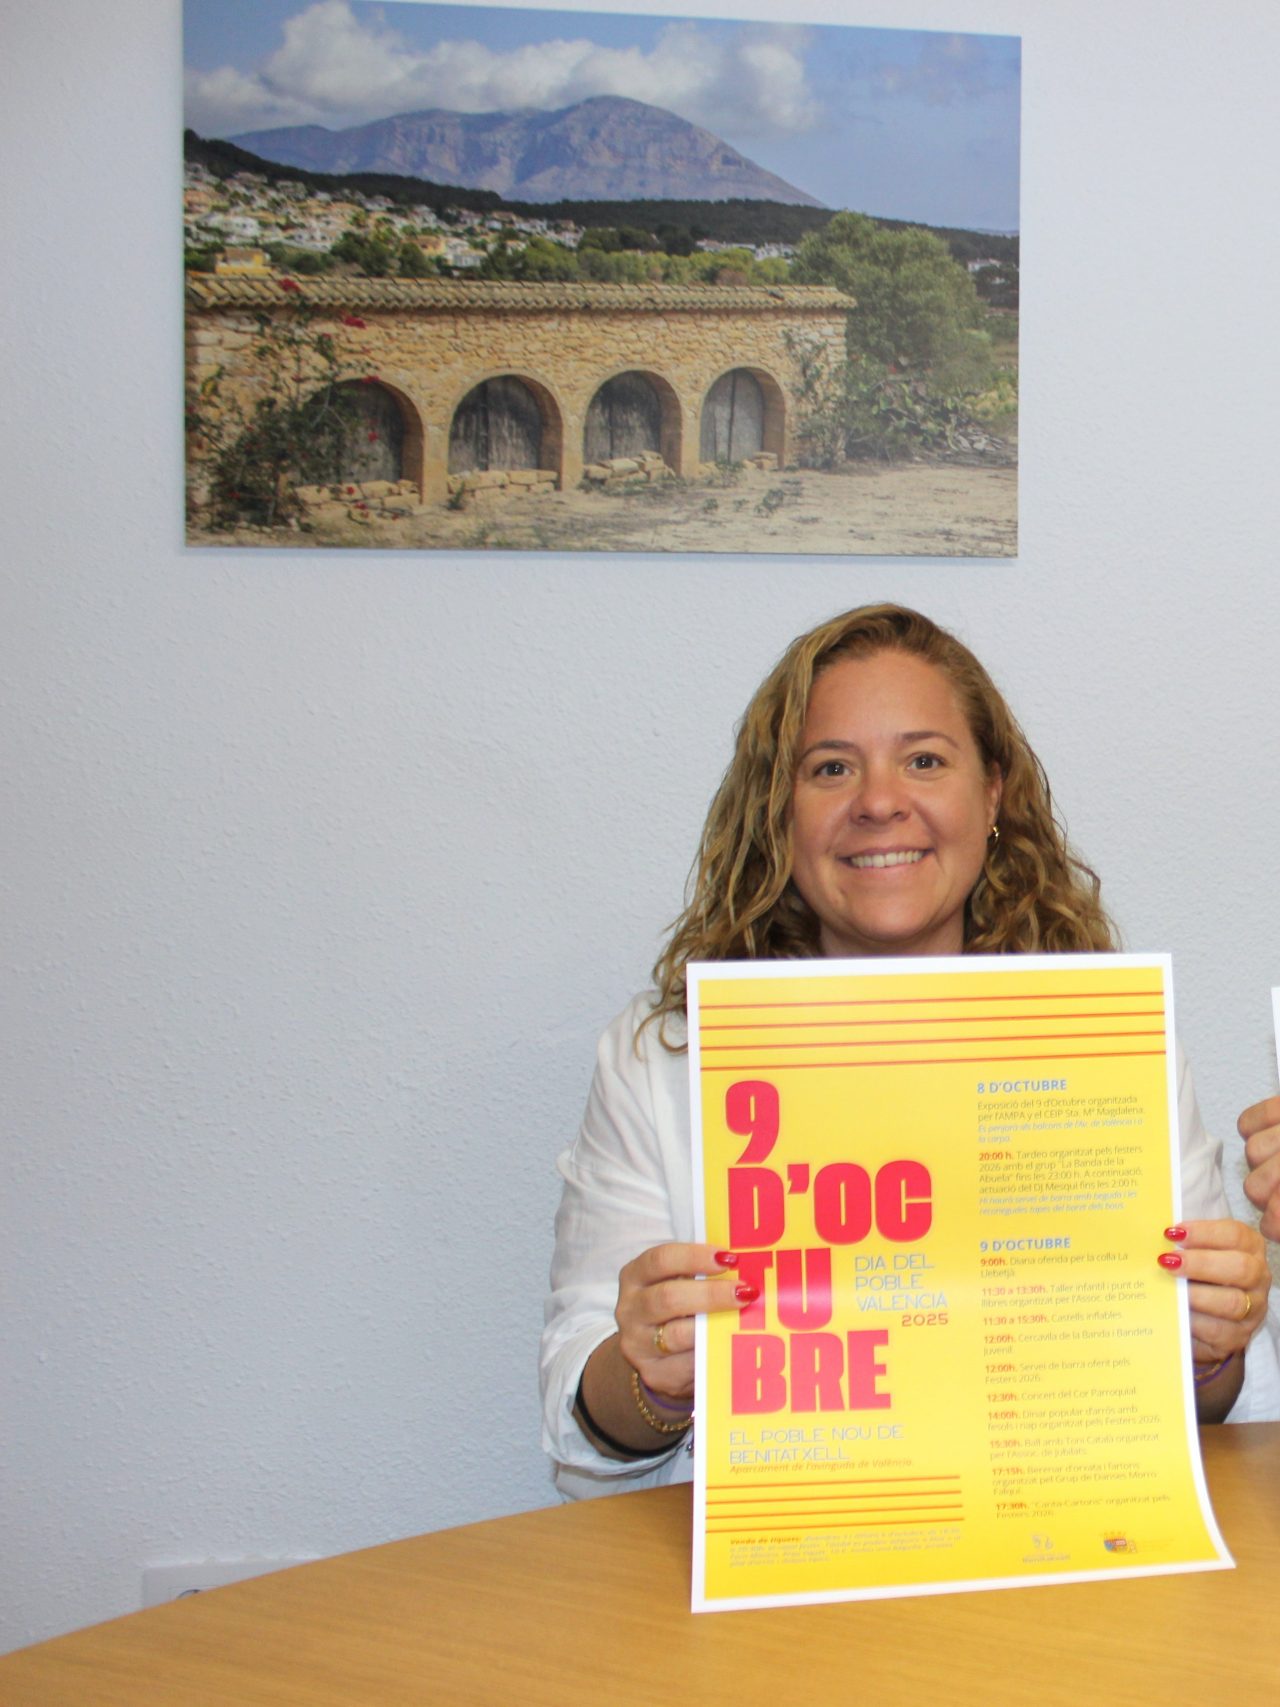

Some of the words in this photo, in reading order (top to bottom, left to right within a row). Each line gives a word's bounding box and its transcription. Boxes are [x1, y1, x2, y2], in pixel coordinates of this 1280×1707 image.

[976, 1083, 985, 1093] 8
[988, 1079, 1067, 1093] D'OCTUBRE
[977, 1100, 1018, 1112] Exposició
[1020, 1099, 1034, 1108] del
[1087, 1094, 1137, 1107] organitzada
[725, 1081, 780, 1163] 9
[977, 1114, 993, 1123] per
[1033, 1110, 1042, 1119] el
[1043, 1109, 1063, 1118] CEIP
[978, 1151, 1003, 1161] 20:00
[1004, 1151, 1013, 1160] h.
[1017, 1149, 1047, 1159] Tardeo
[1049, 1147, 1092, 1160] organitzat
[1094, 1146, 1112, 1157] pels
[1114, 1144, 1142, 1154] festers
[979, 1163, 1000, 1172] 2026
[1002, 1162, 1023, 1171] amb
[1025, 1161, 1033, 1170] el
[1034, 1162, 1056, 1172] grup
[1073, 1158, 1102, 1168] Banda
[1103, 1157, 1115, 1166] de
[1116, 1157, 1124, 1166] la
[727, 1160, 933, 1249] D'OC
[979, 1241, 988, 1252] 9
[992, 1237, 1070, 1251] D'OCTUBRE
[855, 1256, 886, 1272] DIA
[894, 1254, 934, 1270] DEL
[980, 1257, 1008, 1266] 9:00h.
[1009, 1256, 1035, 1265] Diana
[1069, 1256, 1084, 1265] per
[1086, 1253, 1094, 1262] la
[1096, 1252, 1116, 1262] colla
[1117, 1252, 1128, 1261] La
[731, 1248, 832, 1331] TU
[856, 1274, 924, 1290] POBLE
[982, 1287, 1005, 1296] 11:30
[1050, 1283, 1073, 1293] Taller
[1075, 1282, 1105, 1292] infantil
[1110, 1280, 1131, 1292] punt
[1133, 1280, 1144, 1289] de
[902, 1313, 948, 1327] 2025
[984, 1334, 1016, 1344] 12:00h.
[731, 1330, 891, 1415] BRE
[730, 1431, 754, 1446] EL
[761, 1428, 825, 1444] POBLE
[832, 1426, 872, 1441] NOU
[878, 1424, 904, 1440] DE
